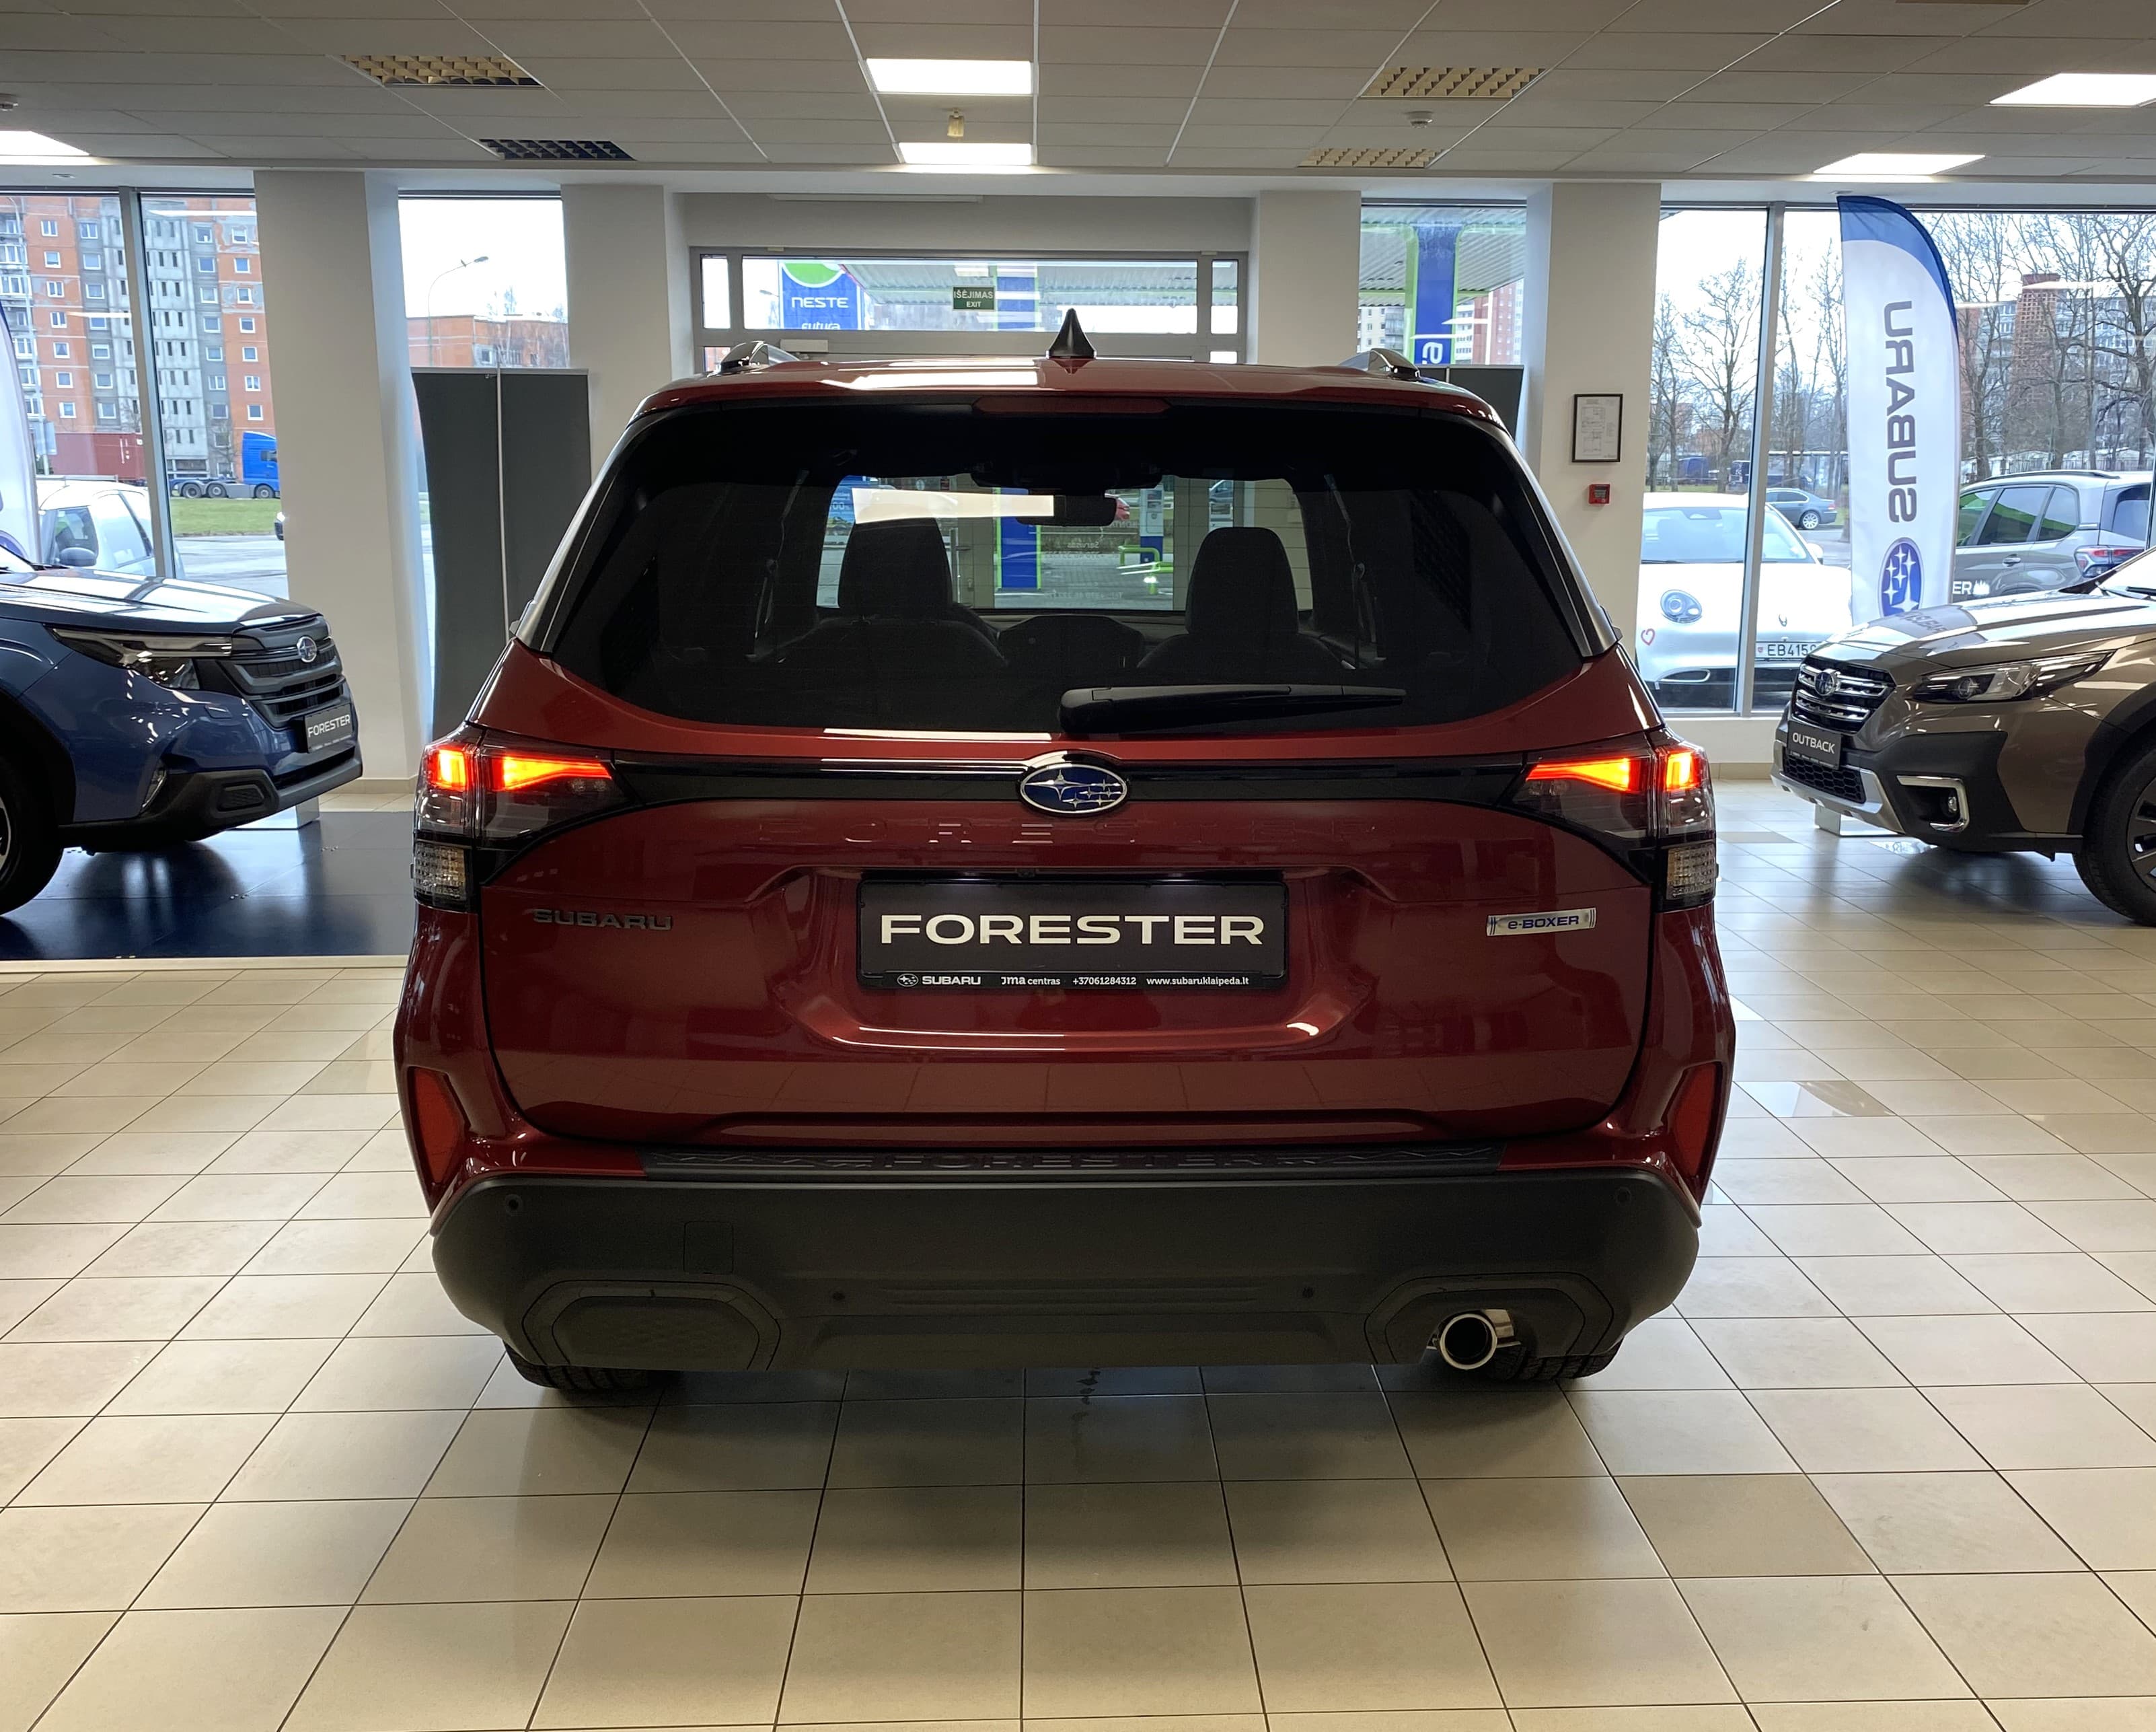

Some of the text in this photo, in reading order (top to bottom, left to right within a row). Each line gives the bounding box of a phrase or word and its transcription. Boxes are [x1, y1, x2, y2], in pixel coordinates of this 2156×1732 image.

[954, 289, 994, 299] IŠĖJIMAS
[791, 297, 849, 308] NESTE
[1952, 581, 1973, 595] ER
[307, 714, 350, 738] FORESTER
[1792, 732, 1836, 754] OUTBACK
[533, 908, 672, 931] SUBARU
[1508, 915, 1579, 930] e-BOXER
[881, 914, 1265, 945] FORESTER
[922, 976, 981, 985] SUBARU
[1027, 977, 1061, 986] centras
[1072, 976, 1137, 985] +37061284312
[1146, 976, 1249, 986] www.subaruklaipeda.lt
